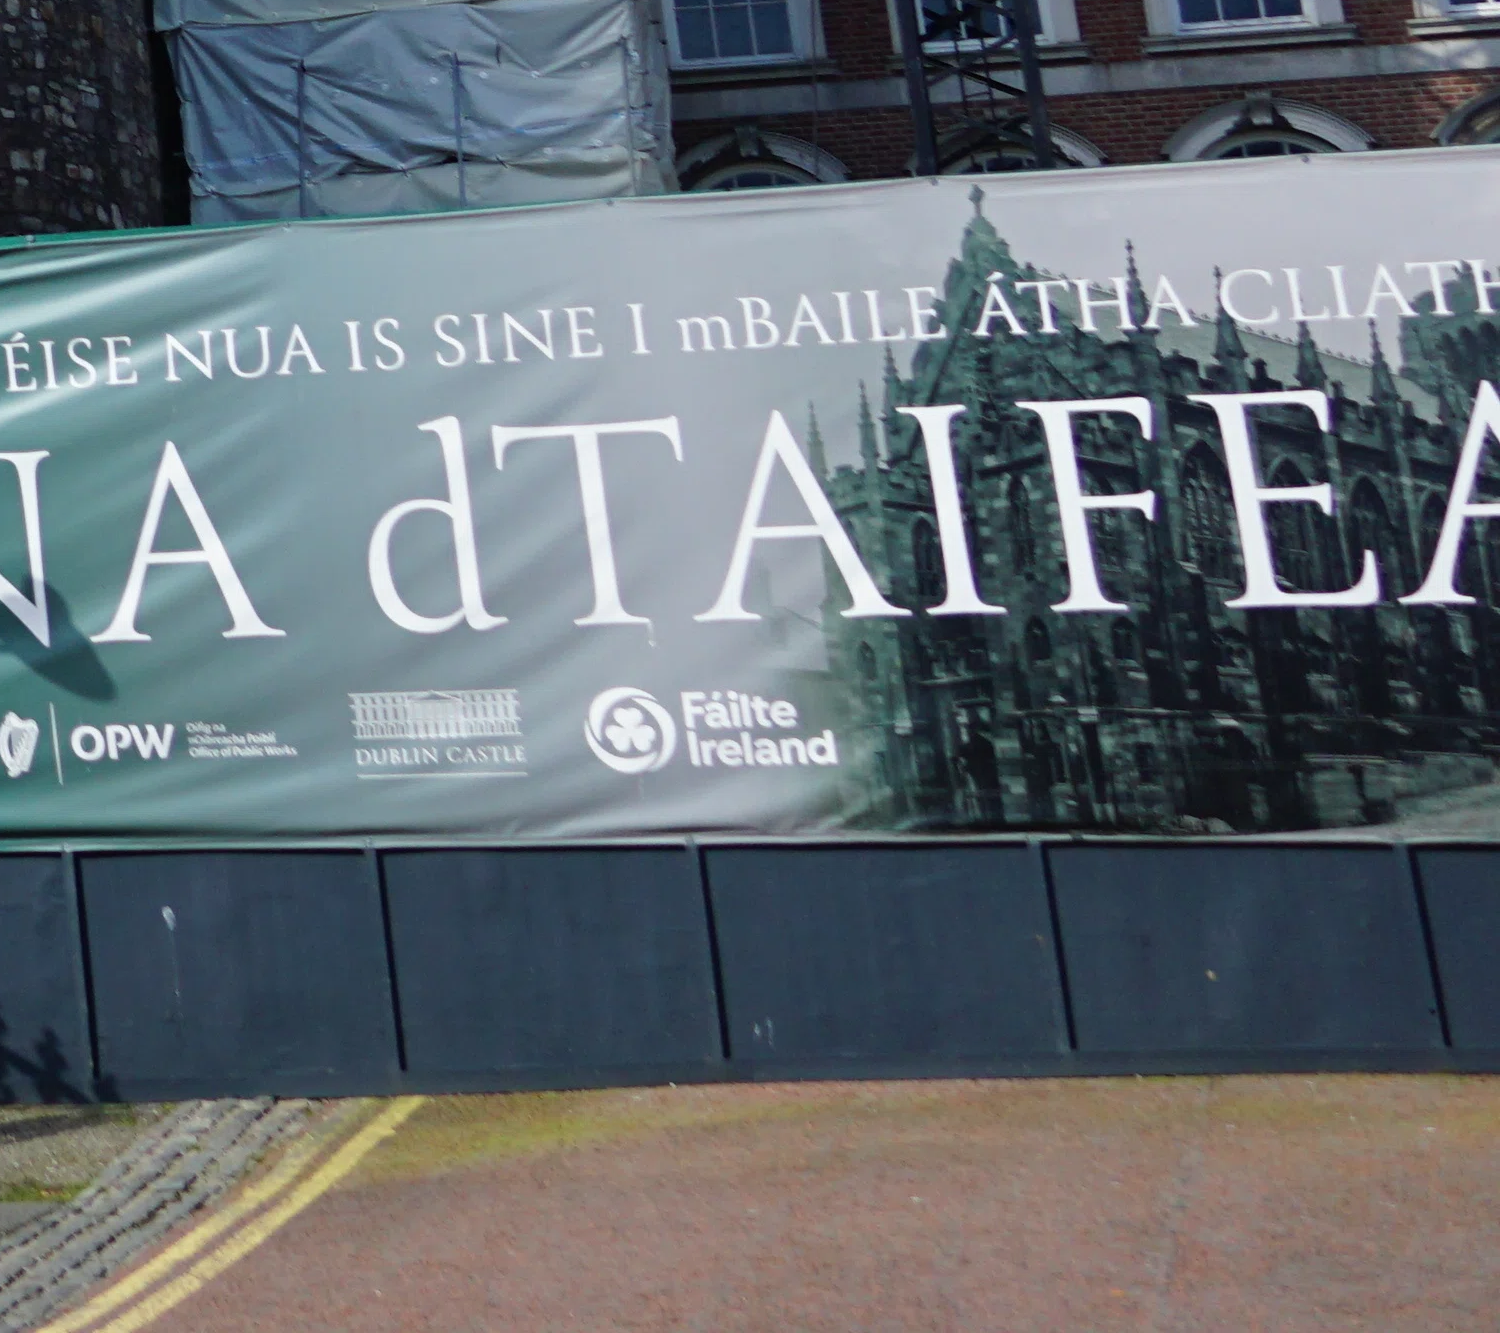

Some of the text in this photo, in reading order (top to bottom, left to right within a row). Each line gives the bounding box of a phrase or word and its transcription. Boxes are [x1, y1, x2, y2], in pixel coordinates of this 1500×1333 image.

[165, 324, 326, 380] NUA
[343, 318, 405, 371] IS
[434, 307, 604, 367] SINE
[626, 303, 652, 355] I
[676, 287, 947, 353] mBAILE
[976, 271, 1200, 336] ÁTHA
[680, 690, 798, 730] Fáilte
[70, 724, 175, 762] OPW
[354, 744, 528, 766] DUBLIN CASTLE
[685, 729, 840, 767] Ireland
